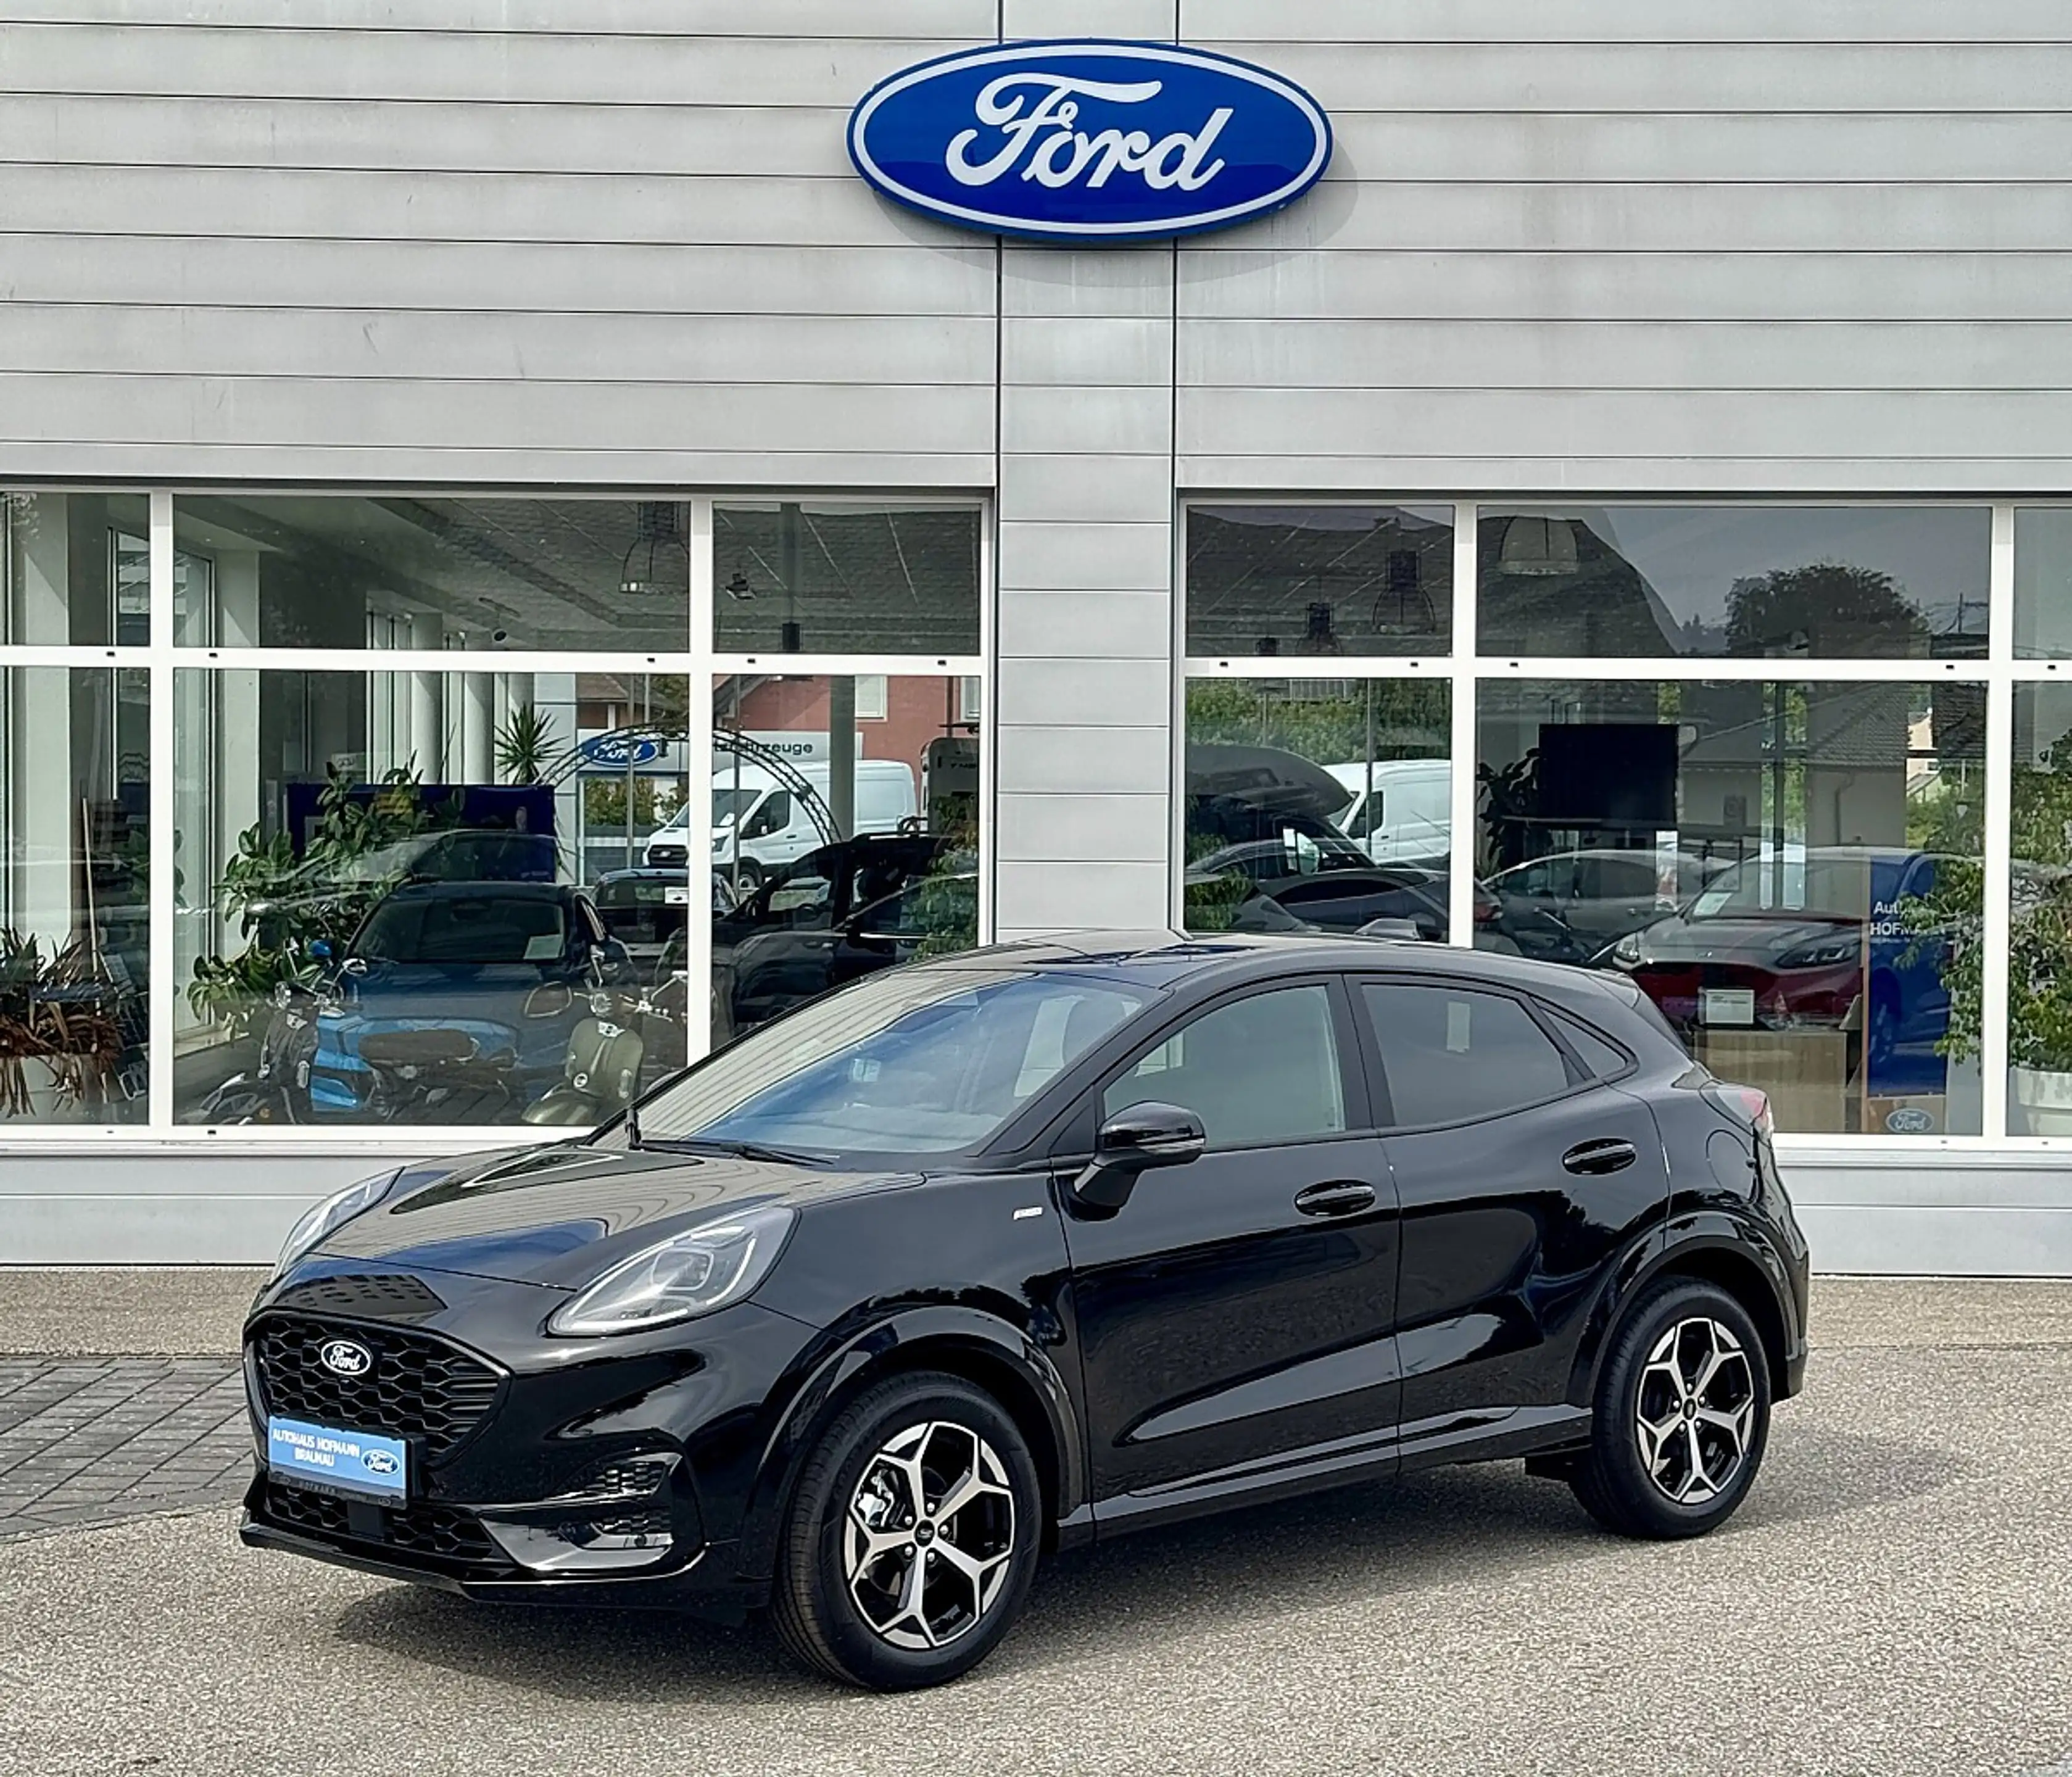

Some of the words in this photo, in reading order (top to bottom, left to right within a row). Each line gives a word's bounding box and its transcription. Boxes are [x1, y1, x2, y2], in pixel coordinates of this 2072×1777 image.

[945, 72, 1234, 191] Ford
[1894, 1112, 1926, 1130] Ford
[329, 1344, 362, 1370] Ford
[273, 1428, 315, 1448] AUTOHAUS
[317, 1436, 360, 1457] HOFMANN
[294, 1448, 334, 1467] BRAUNAU
[367, 1451, 393, 1472] Ford
